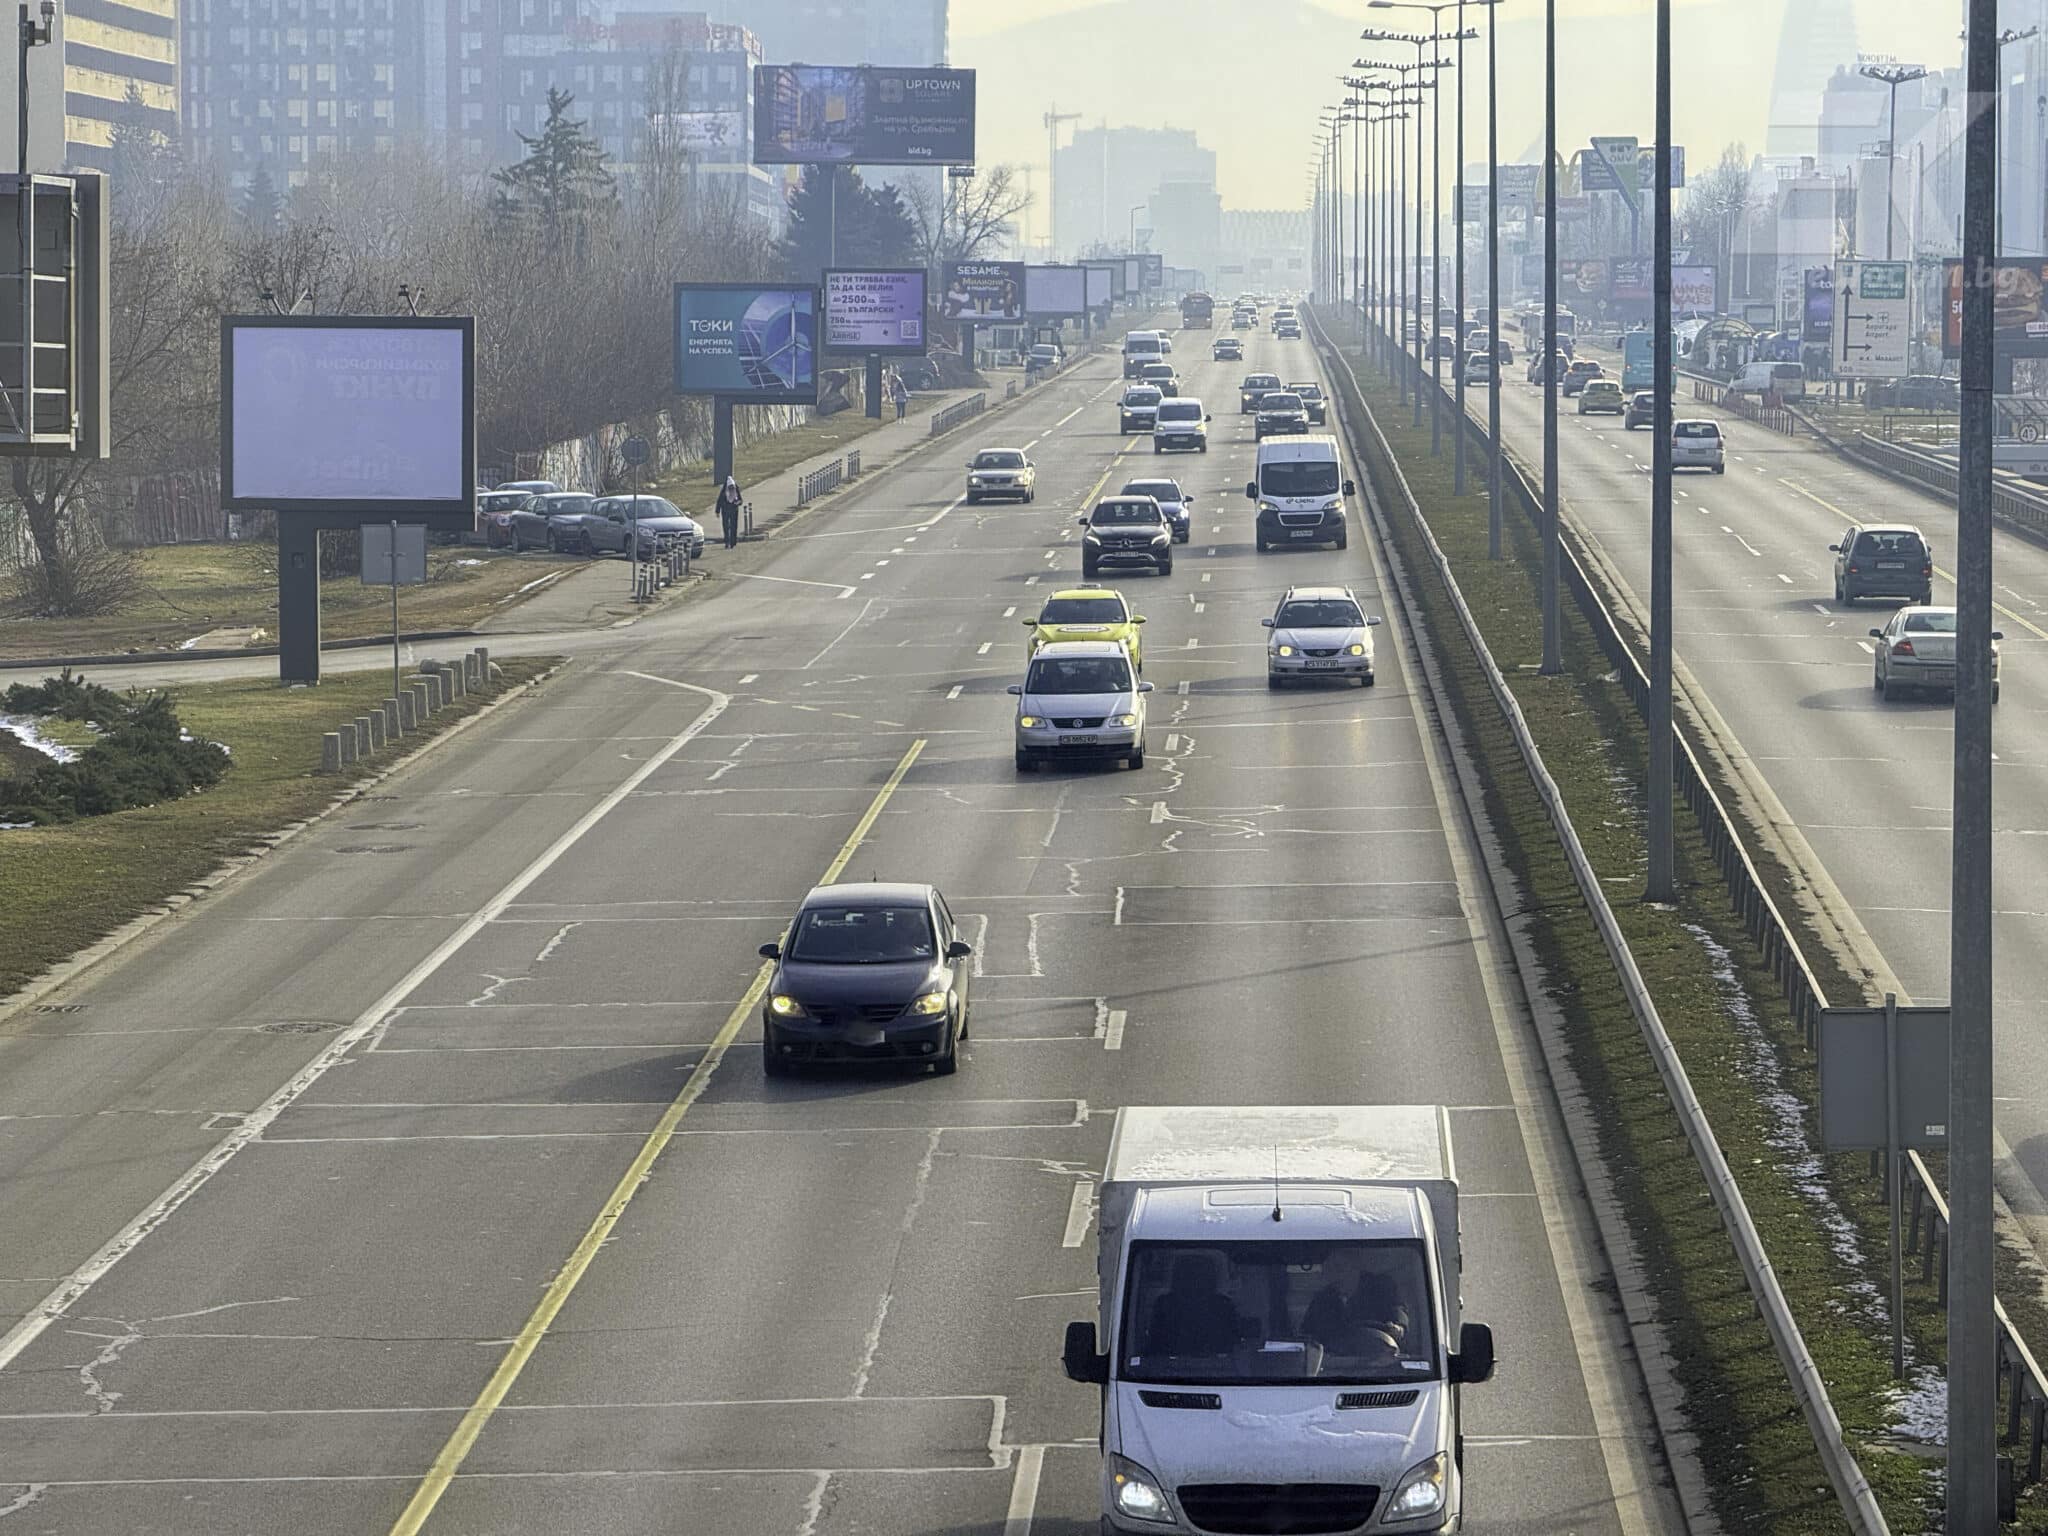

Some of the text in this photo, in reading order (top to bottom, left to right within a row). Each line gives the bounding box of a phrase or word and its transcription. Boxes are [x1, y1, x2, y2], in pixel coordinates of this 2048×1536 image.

[905, 79, 960, 90] UPTOWN
[842, 284, 854, 292] ДА
[842, 294, 867, 304] 2500
[688, 319, 733, 333] ТОКИ
[688, 338, 734, 346] ЕНЕРГИЯТА
[703, 347, 733, 355] УСПЕХА
